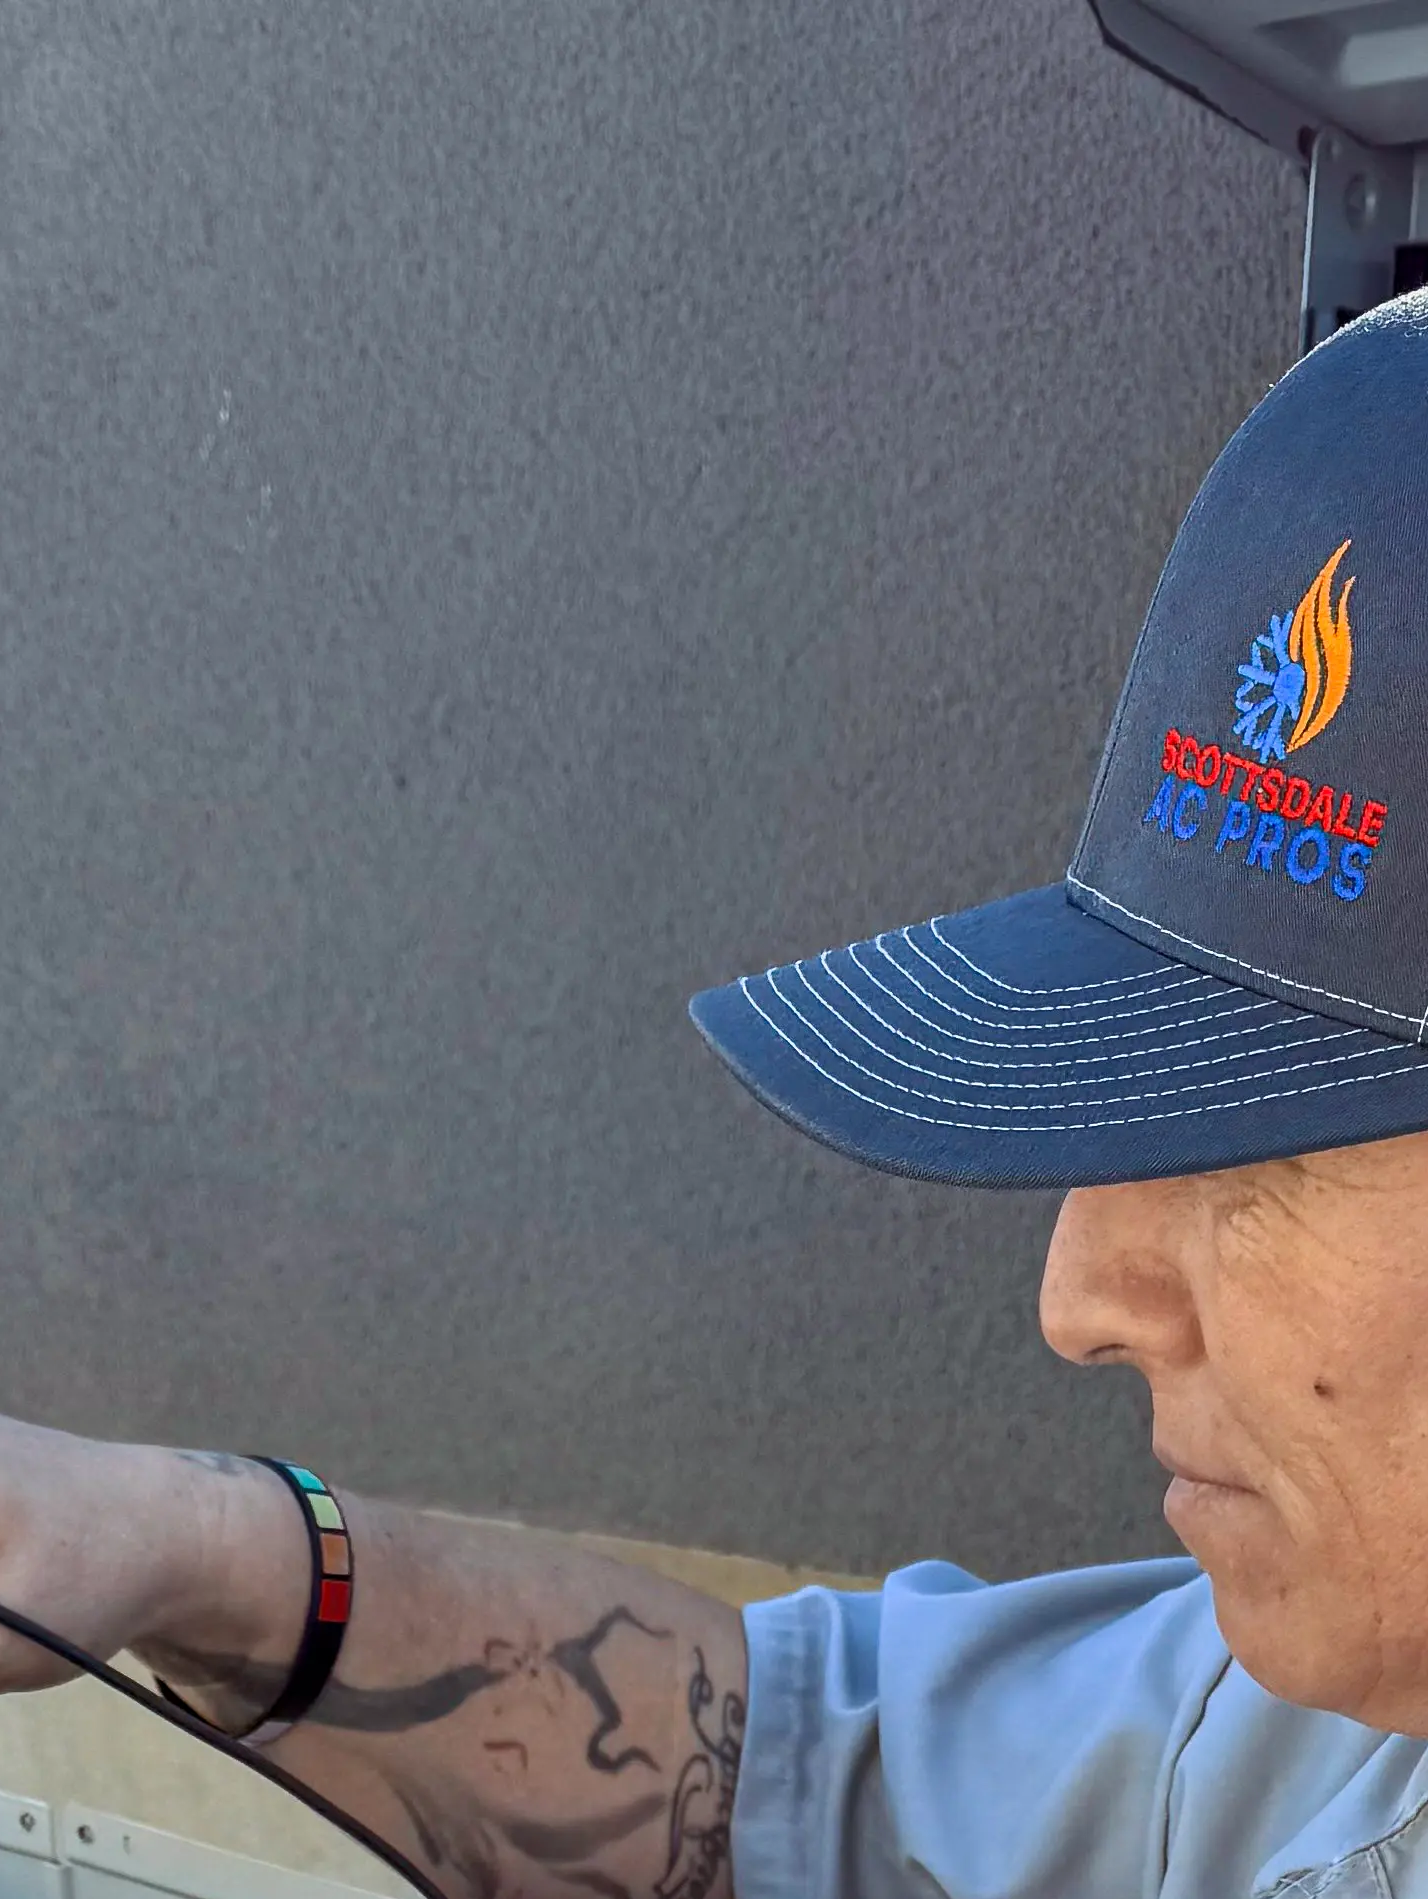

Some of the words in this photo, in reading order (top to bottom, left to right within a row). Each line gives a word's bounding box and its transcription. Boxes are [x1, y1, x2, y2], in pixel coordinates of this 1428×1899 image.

[1143, 774, 1208, 841] AC
[1215, 800, 1374, 901] PROS
[1161, 727, 1388, 847] SCOTTSDALE
